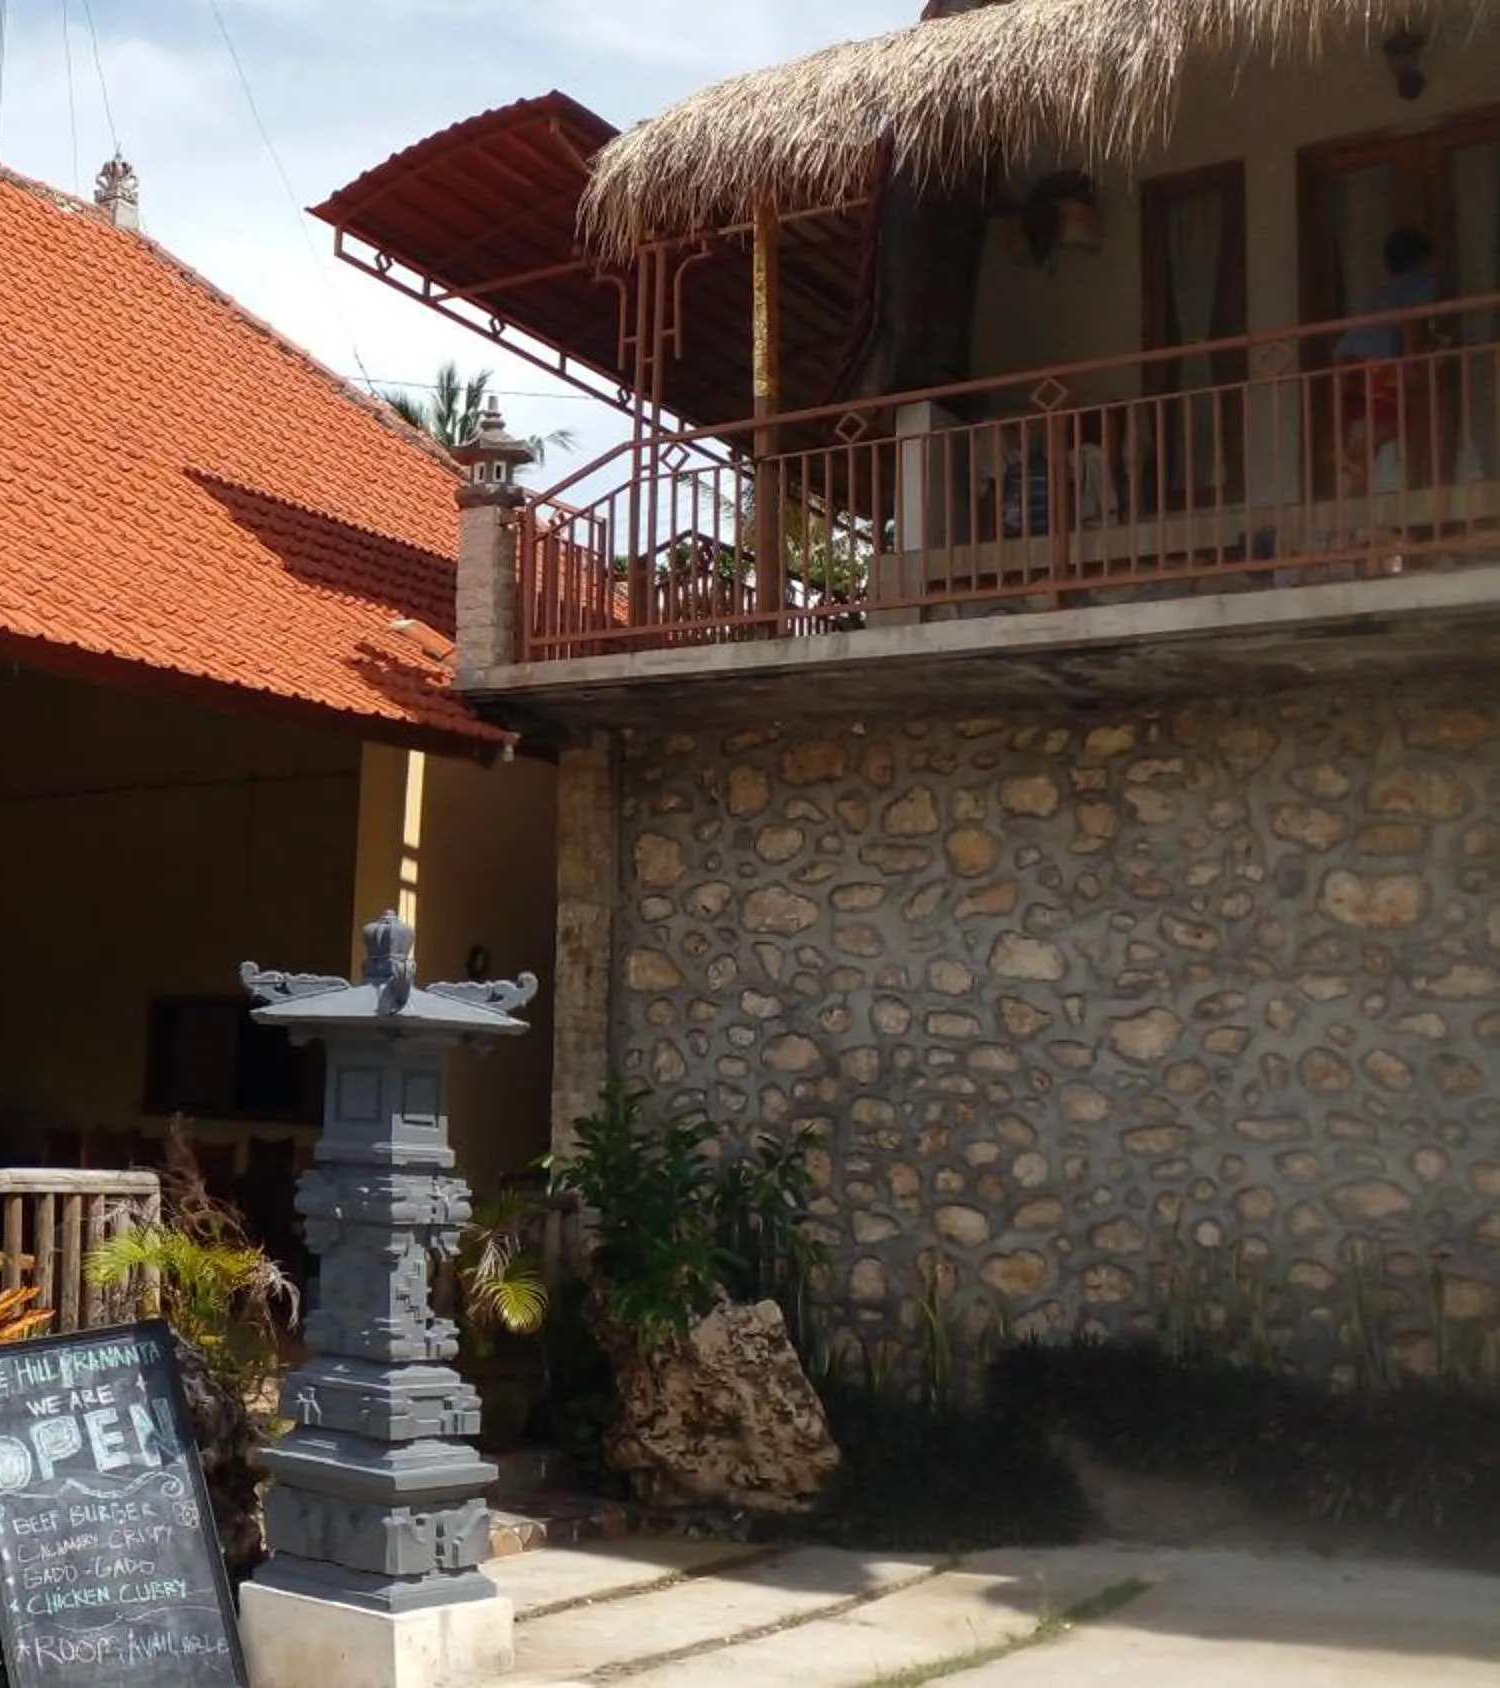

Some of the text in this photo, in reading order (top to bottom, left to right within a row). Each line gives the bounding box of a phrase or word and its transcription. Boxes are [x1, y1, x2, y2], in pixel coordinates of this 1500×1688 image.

[14, 1357, 60, 1389] HILL
[25, 1383, 116, 1418] WE ARE
[12, 1501, 158, 1535] BEEF BURGER
[26, 1578, 188, 1615] CHICKEN CURRY
